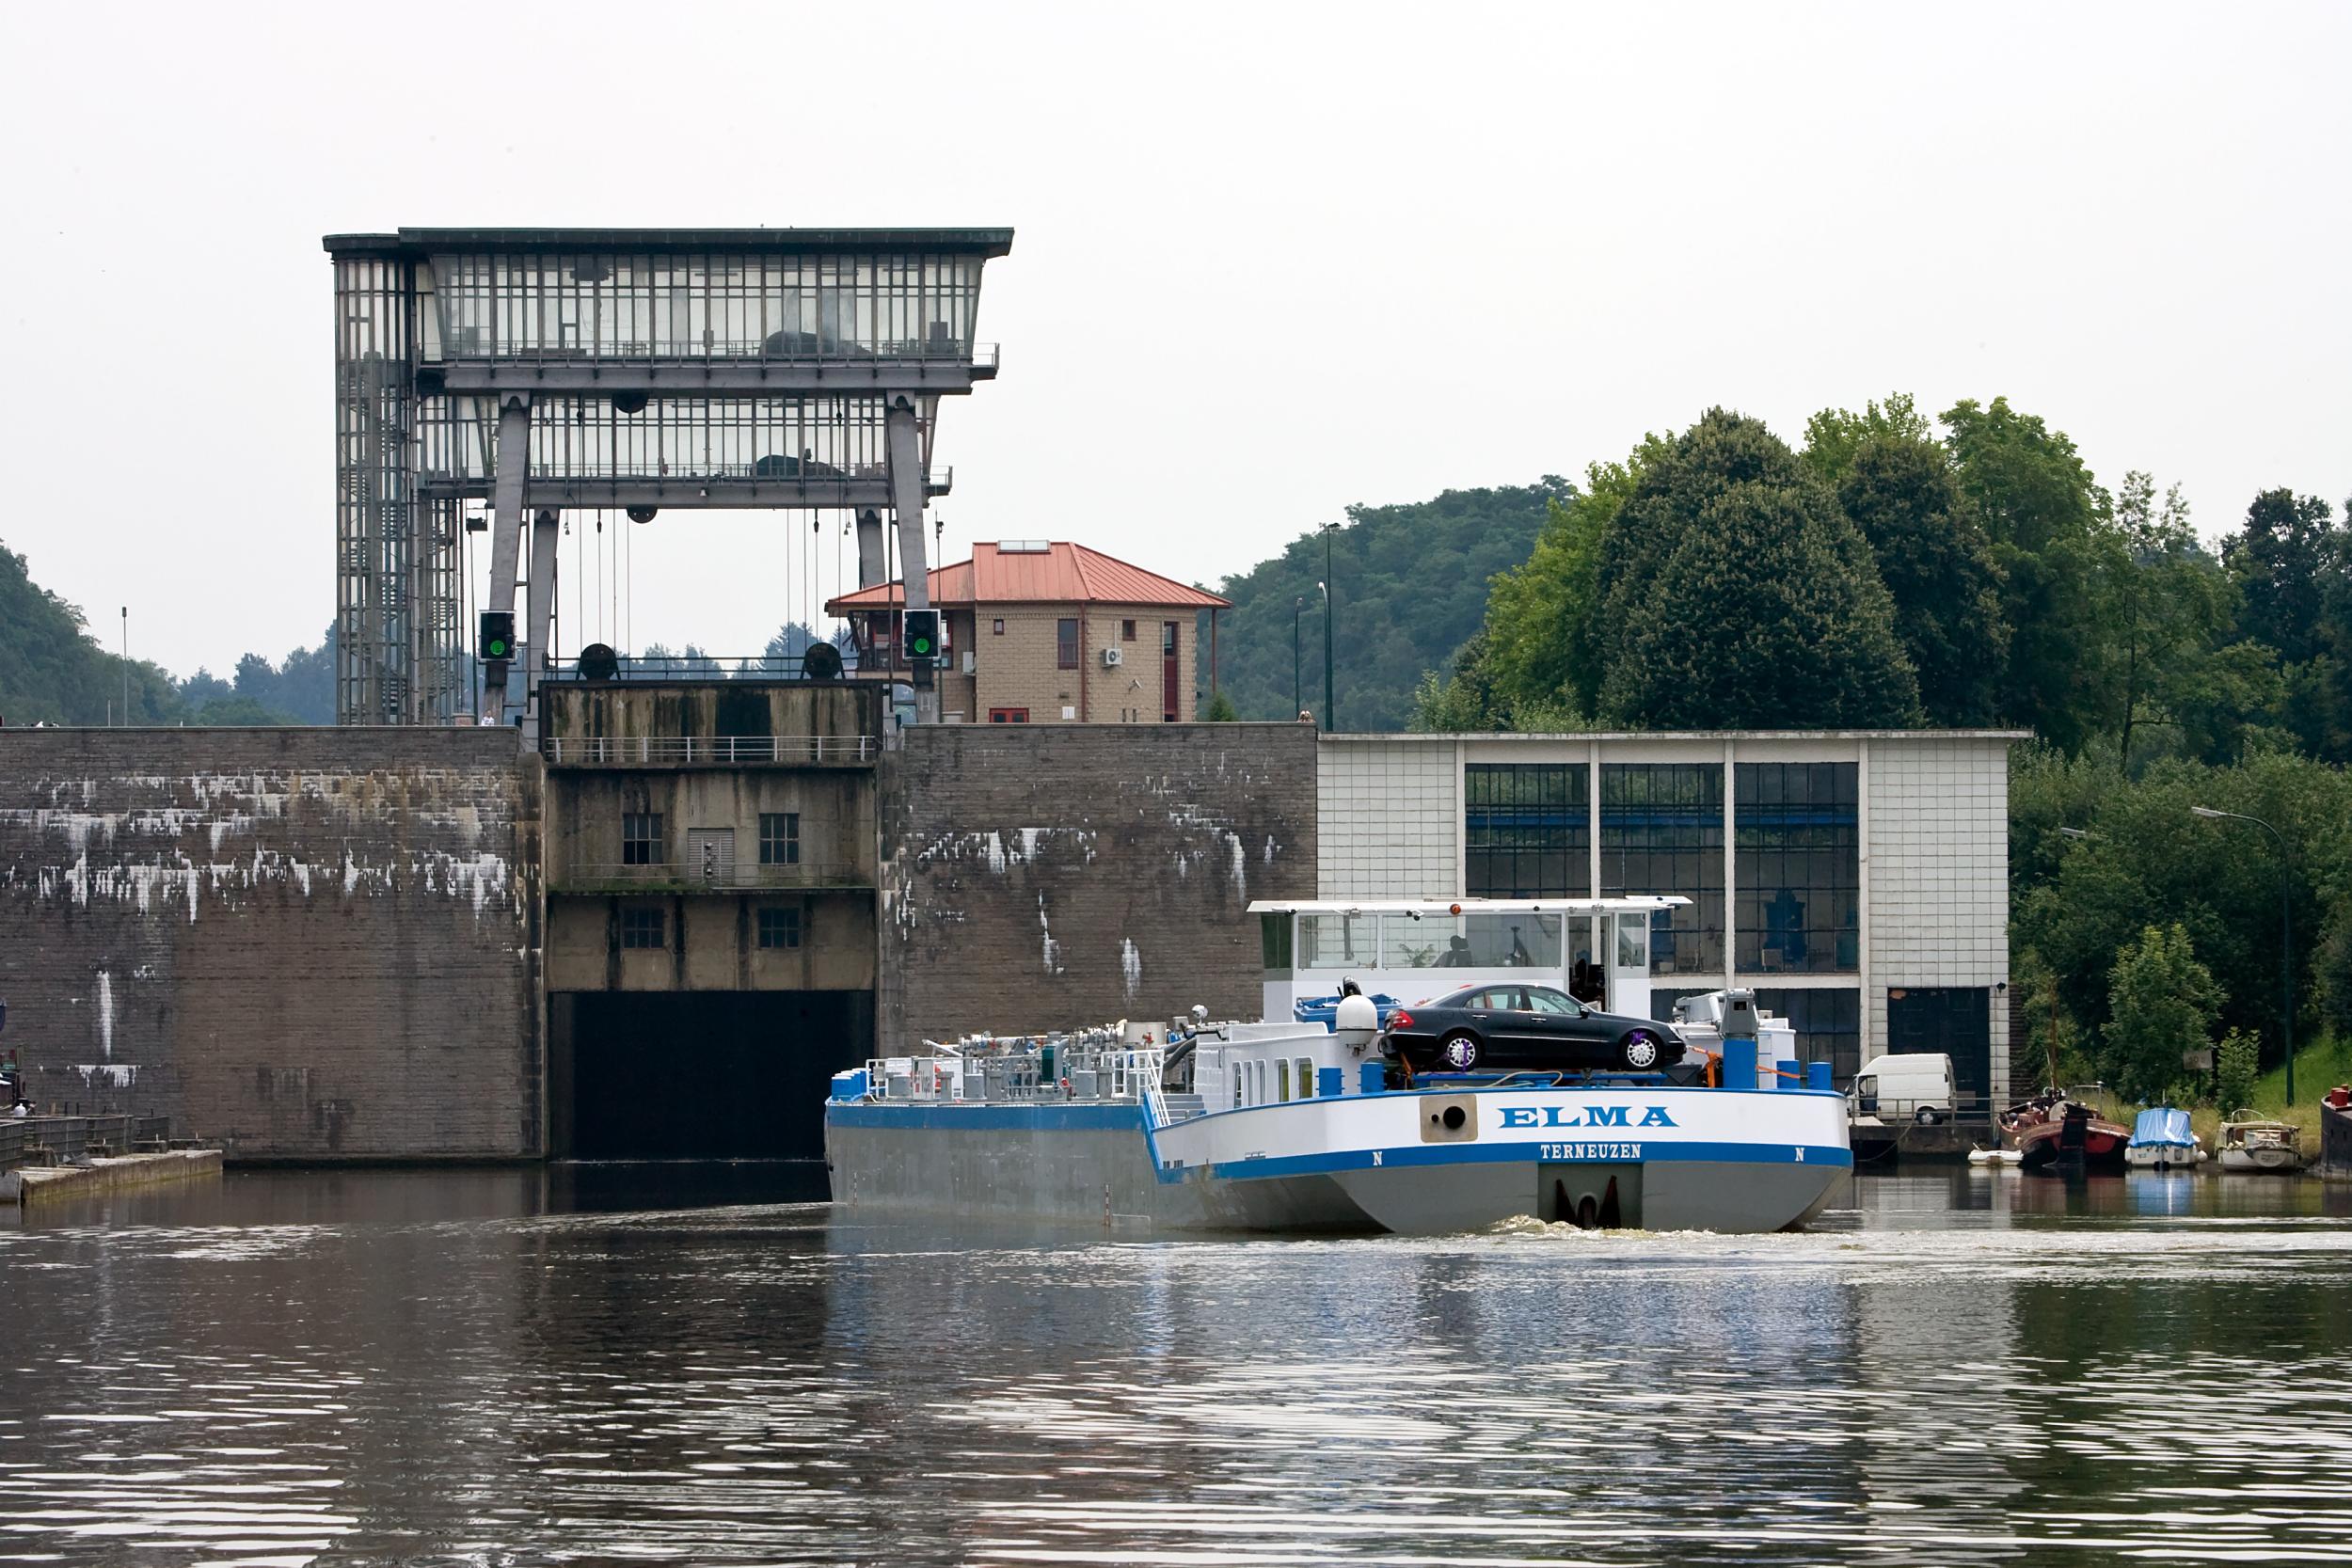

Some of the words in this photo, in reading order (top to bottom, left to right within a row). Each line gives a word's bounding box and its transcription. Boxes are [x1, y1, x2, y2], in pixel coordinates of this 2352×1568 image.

[1498, 1105, 1680, 1129] ELMA
[1373, 1150, 1383, 1166] N
[1540, 1144, 1643, 1160] TERNEUZEN
[1795, 1147, 1804, 1163] N
